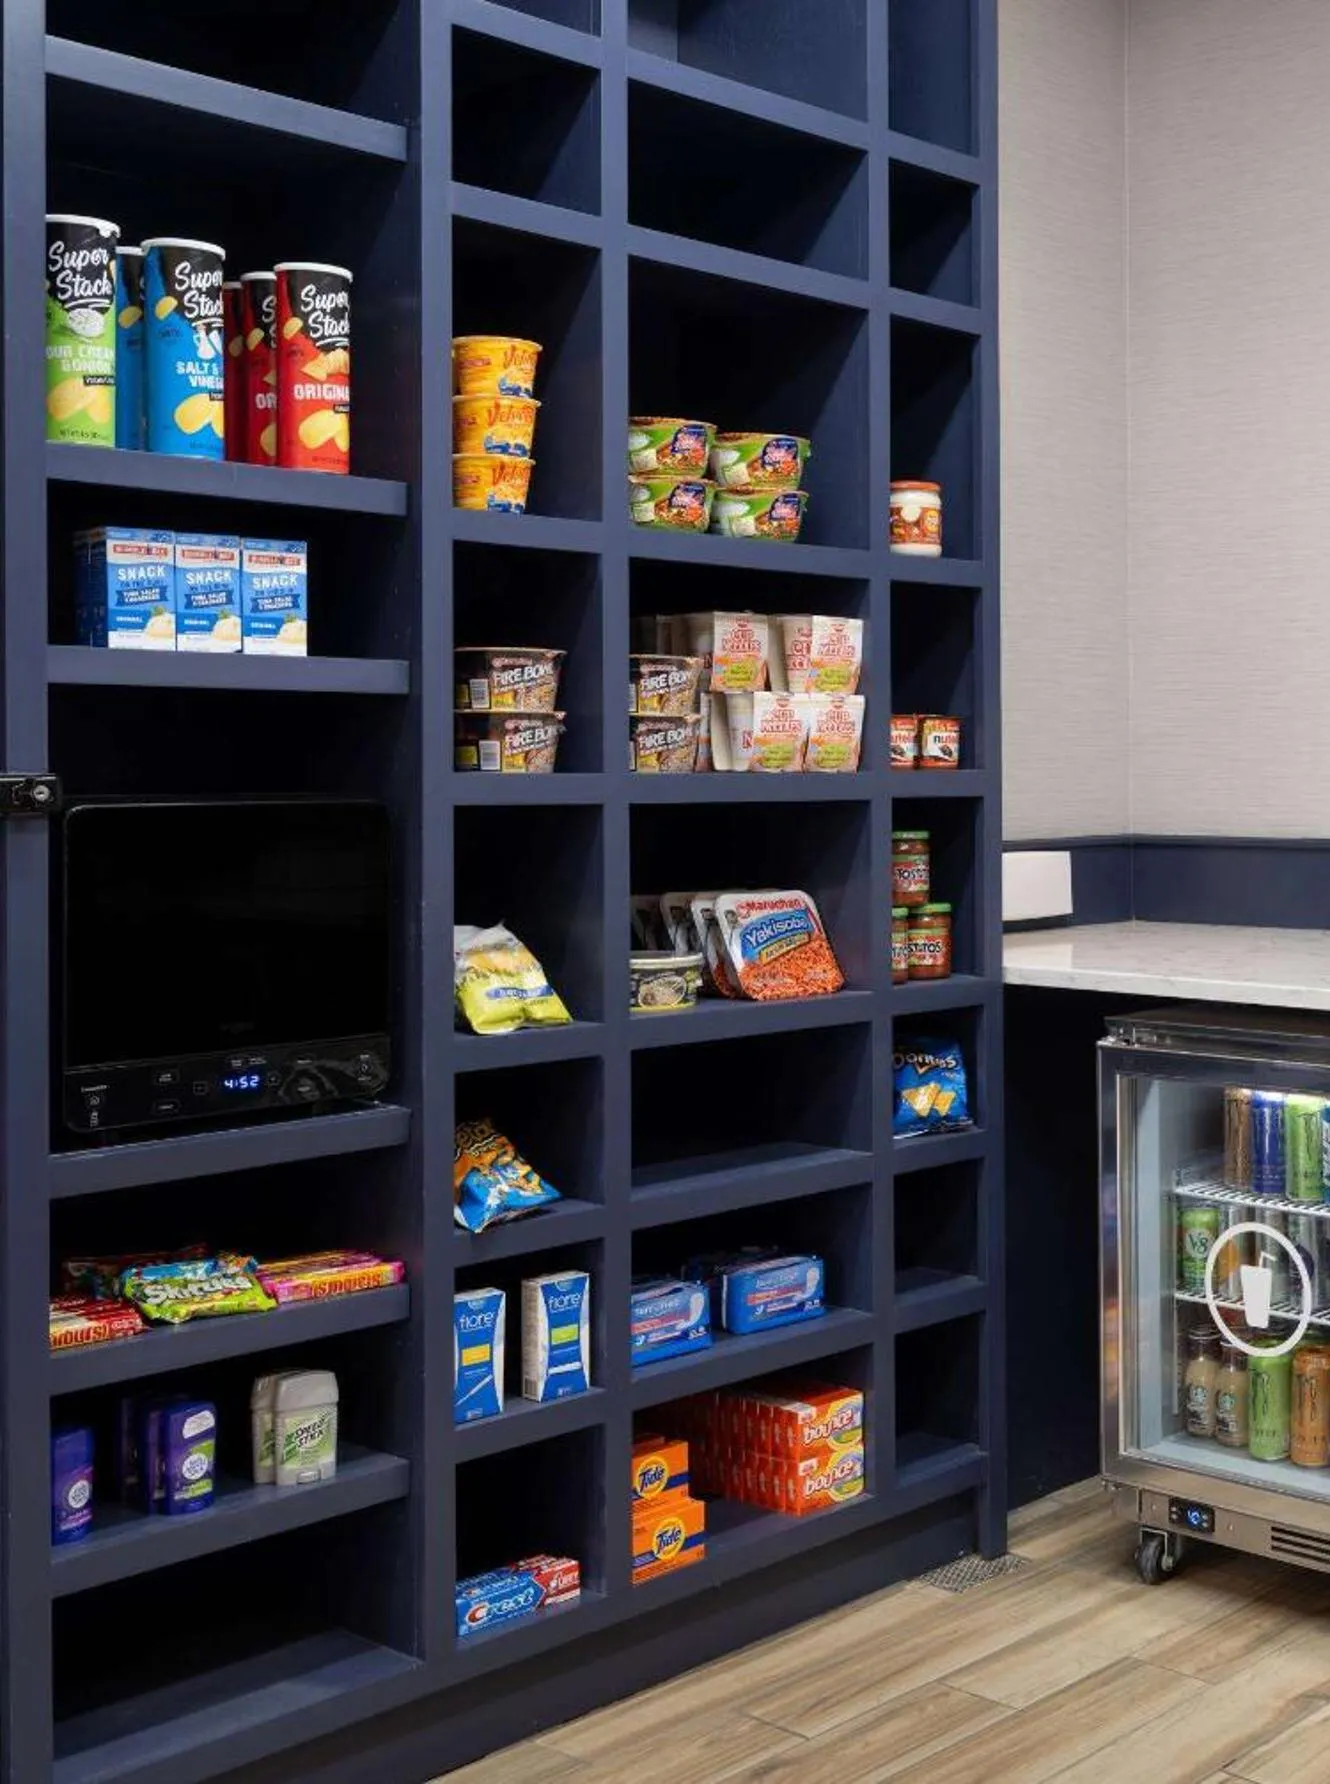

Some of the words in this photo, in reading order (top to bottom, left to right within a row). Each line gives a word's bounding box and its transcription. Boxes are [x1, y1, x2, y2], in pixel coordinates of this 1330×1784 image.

[48, 241, 110, 272] Super
[56, 270, 113, 301] Stack
[175, 360, 209, 376] SALT
[117, 564, 166, 582] SNACK
[185, 570, 233, 586] SNACK
[252, 574, 298, 590] SNACK
[224, 1075, 260, 1089] 4:52
[803, 1409, 853, 1444] bounce
[638, 1465, 666, 1490] Tide
[805, 1460, 855, 1498] bounce
[655, 1526, 682, 1555] Tide
